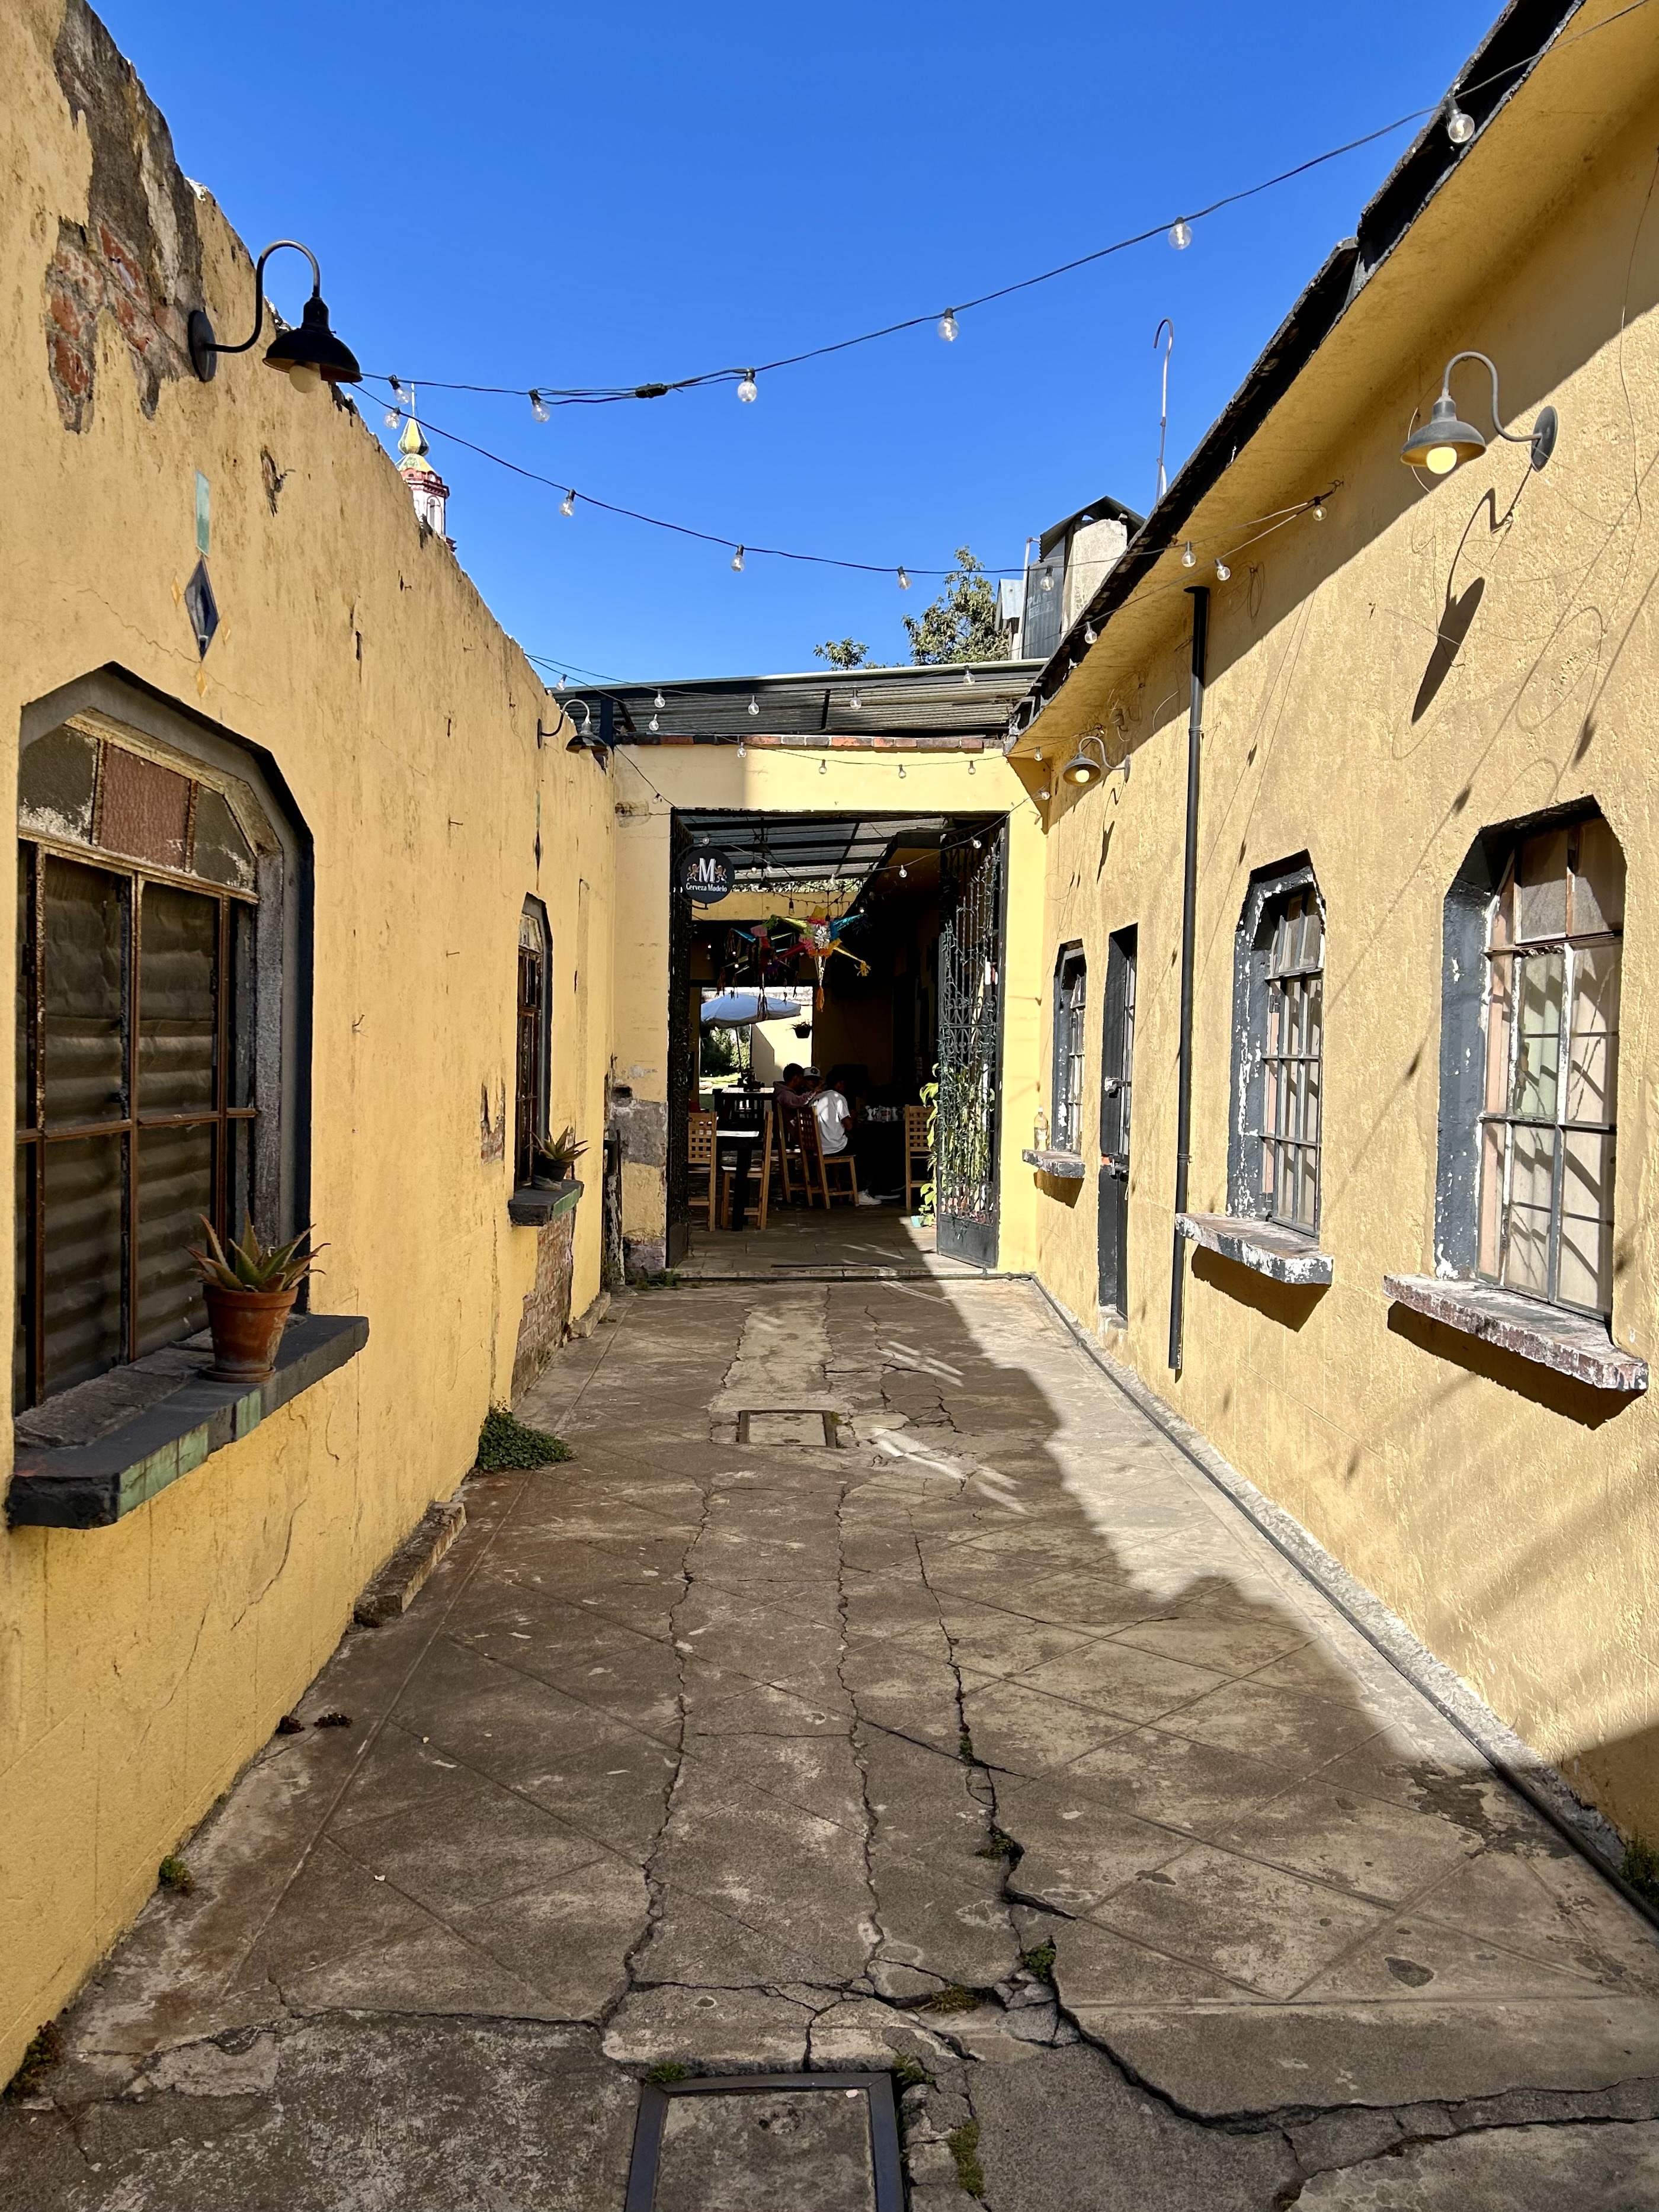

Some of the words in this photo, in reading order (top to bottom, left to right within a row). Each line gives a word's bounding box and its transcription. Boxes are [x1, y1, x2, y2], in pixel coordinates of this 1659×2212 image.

[699, 858, 716, 883] M
[686, 882, 707, 891] Cerveza
[707, 884, 728, 892] Modelo
